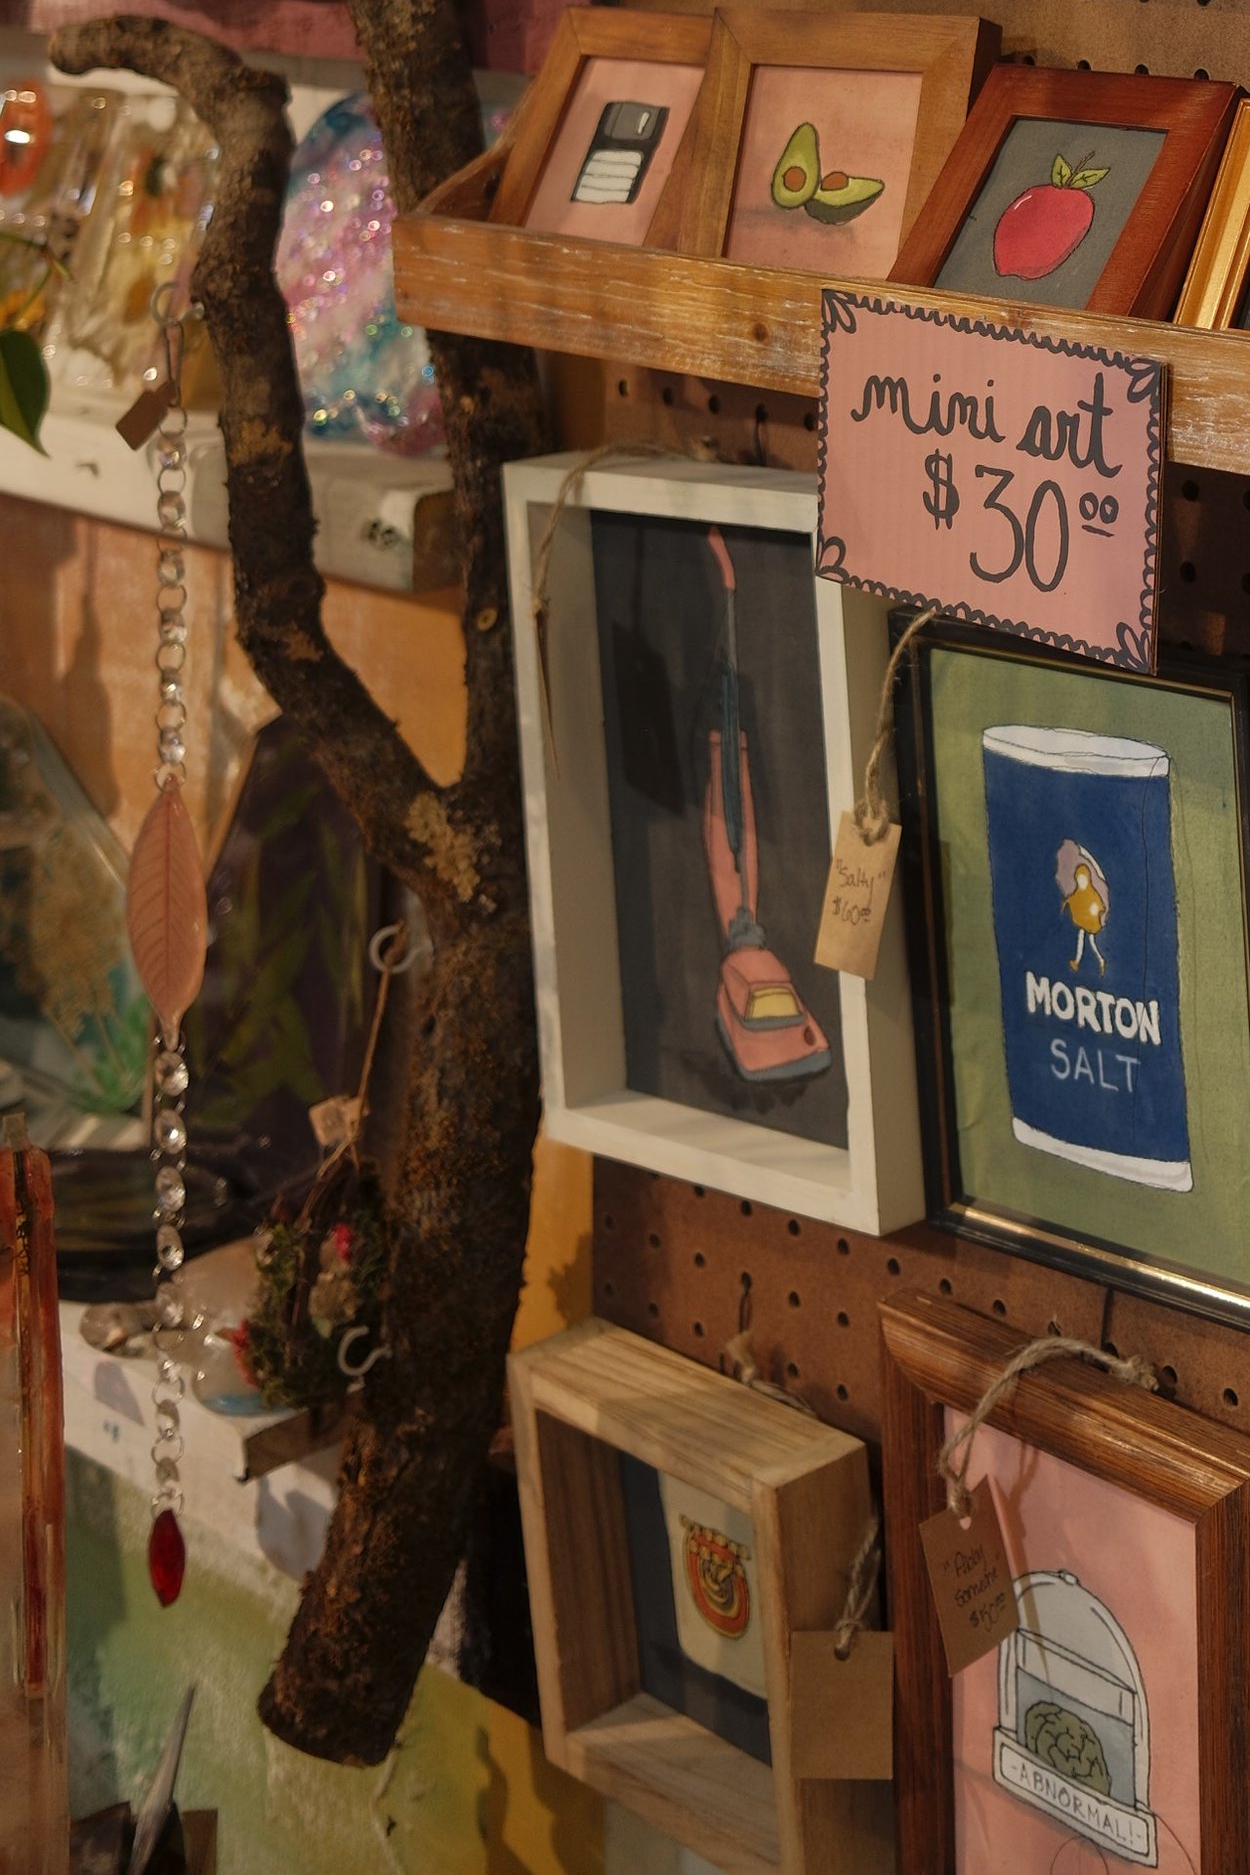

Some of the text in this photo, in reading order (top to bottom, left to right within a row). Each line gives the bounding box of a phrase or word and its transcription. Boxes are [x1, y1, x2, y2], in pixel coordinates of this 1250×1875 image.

[850, 372, 1123, 478] mini art
[1025, 971, 1161, 1046] MORTON
[1050, 1038, 1141, 1093] SALT
